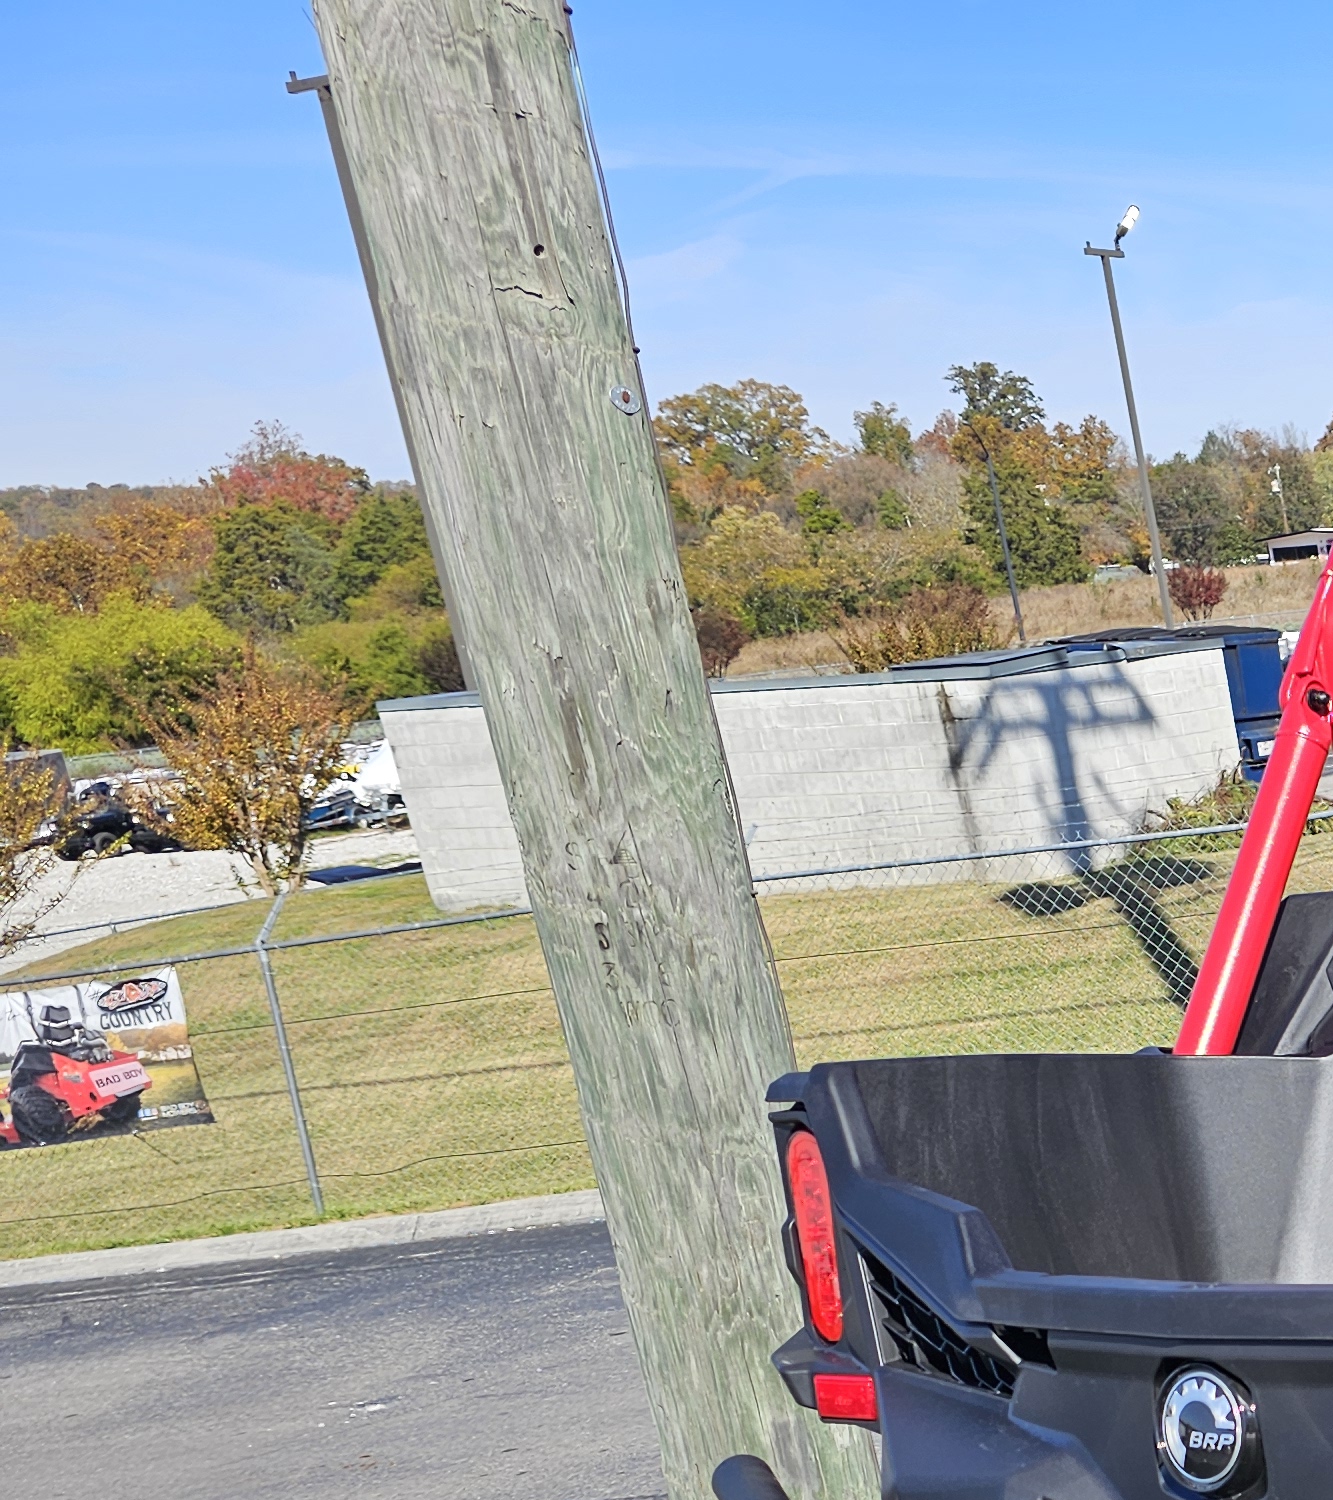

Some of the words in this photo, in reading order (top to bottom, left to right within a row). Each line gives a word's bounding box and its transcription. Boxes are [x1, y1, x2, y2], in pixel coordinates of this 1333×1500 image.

[100, 1001, 173, 1030] COUNTRY
[95, 1074, 121, 1088] BAD
[122, 1068, 143, 1081] BOY
[1189, 1430, 1235, 1451] BRP
